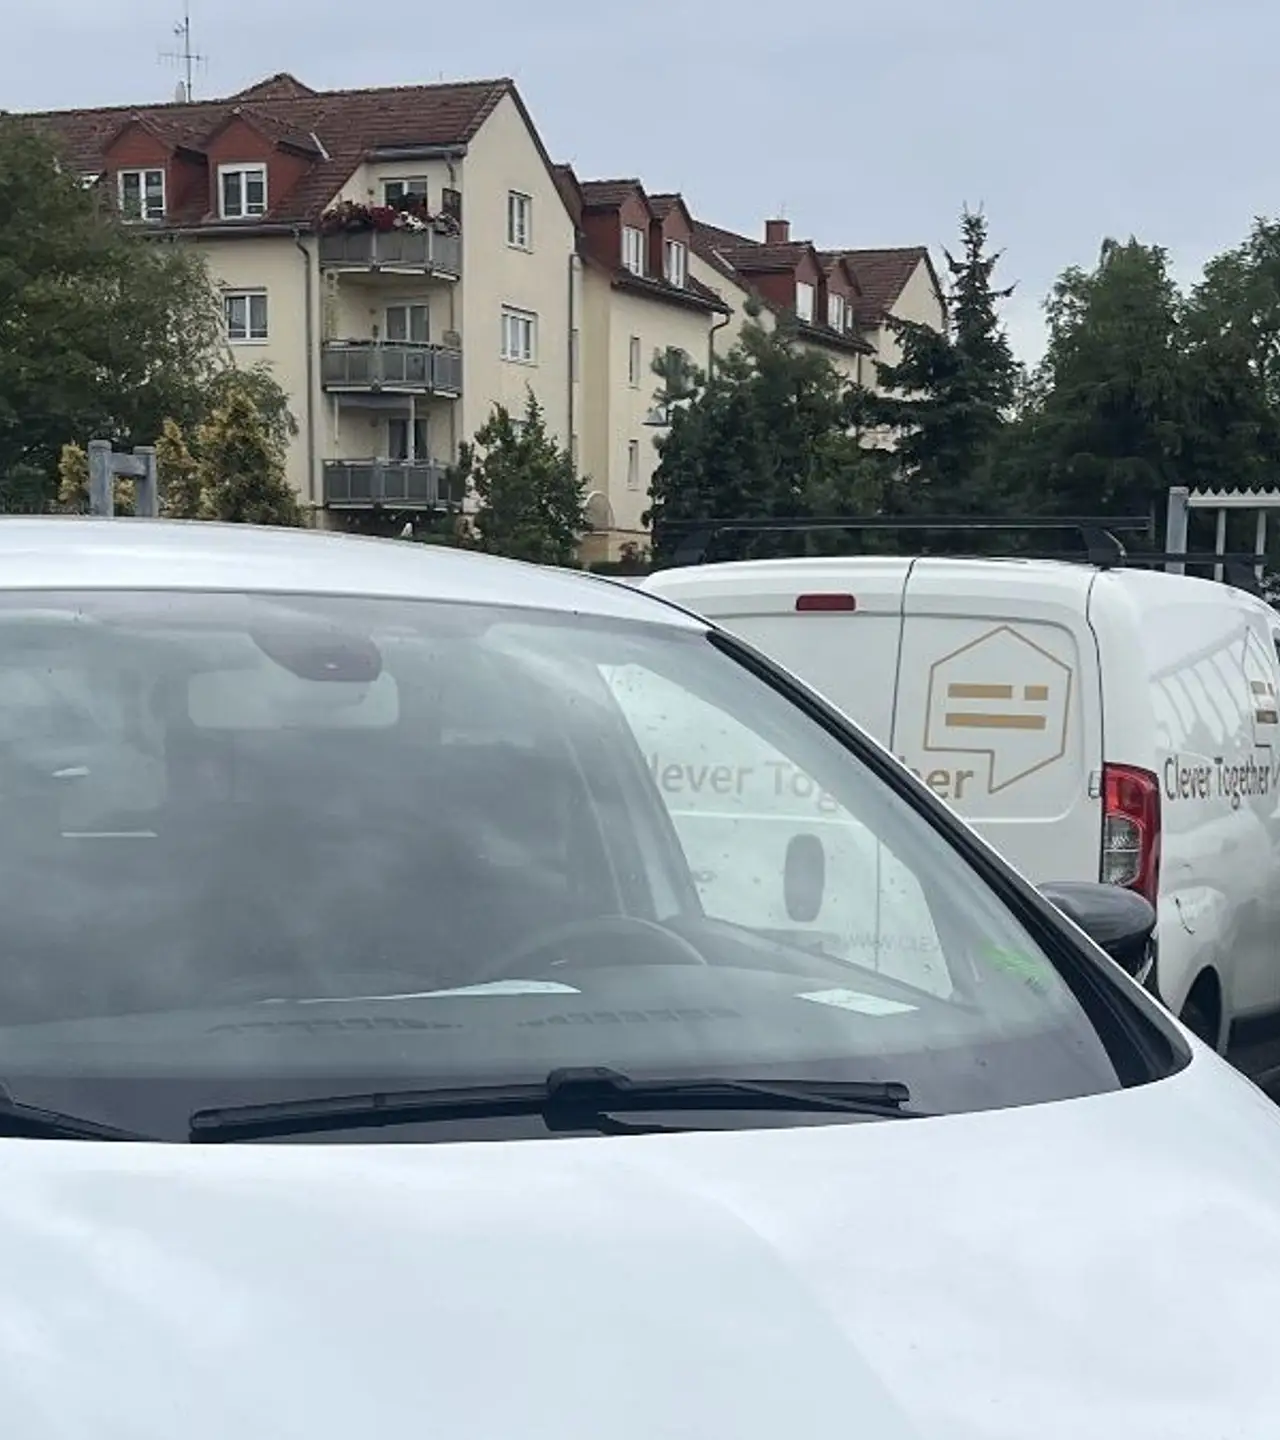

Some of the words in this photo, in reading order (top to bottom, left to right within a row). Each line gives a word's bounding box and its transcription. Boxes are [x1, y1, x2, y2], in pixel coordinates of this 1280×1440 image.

[648, 752, 754, 796] lever
[1163, 754, 1212, 801] Clever
[1213, 754, 1270, 811] Together
